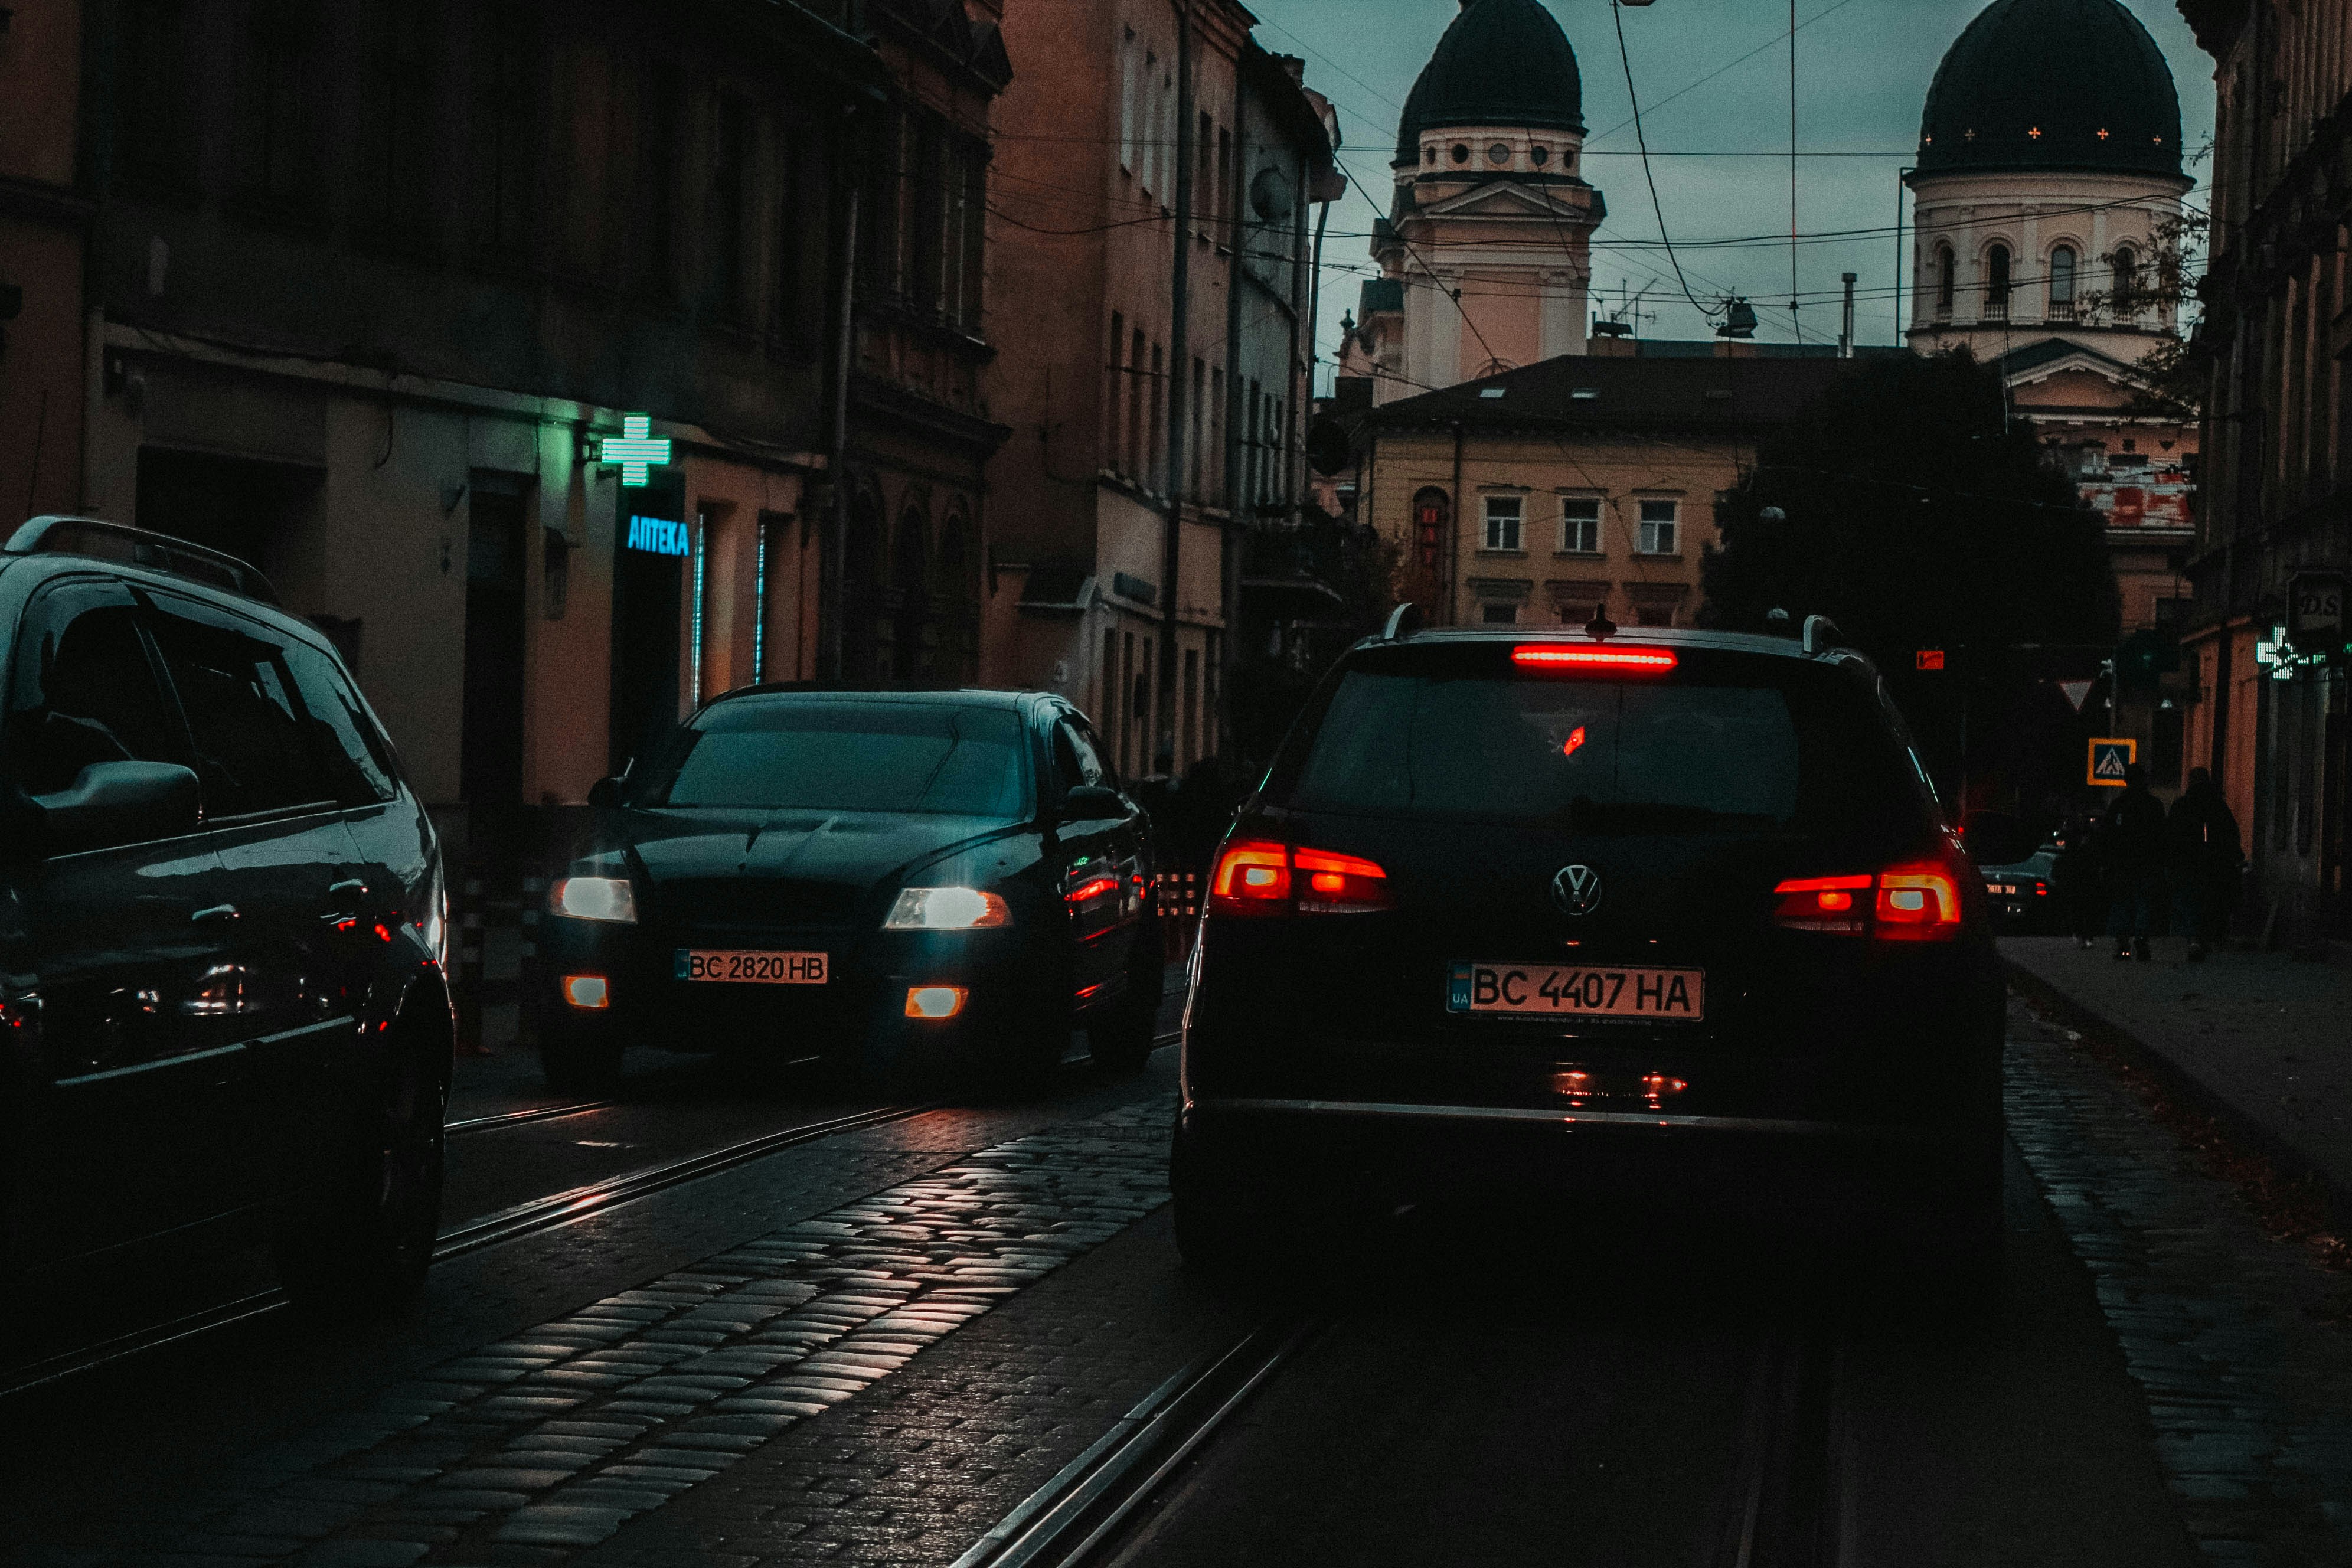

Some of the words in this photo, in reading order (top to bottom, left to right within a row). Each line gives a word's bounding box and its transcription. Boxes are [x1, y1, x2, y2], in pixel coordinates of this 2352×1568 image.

[628, 515, 690, 557] АПТЕКА
[690, 955, 723, 978] BC
[728, 956, 785, 979] 2820
[789, 957, 824, 980] HB
[1452, 993, 1468, 1004] UA
[1474, 968, 1527, 1005] BC
[1538, 971, 1626, 1009] 4407
[1636, 974, 1691, 1012] HA
